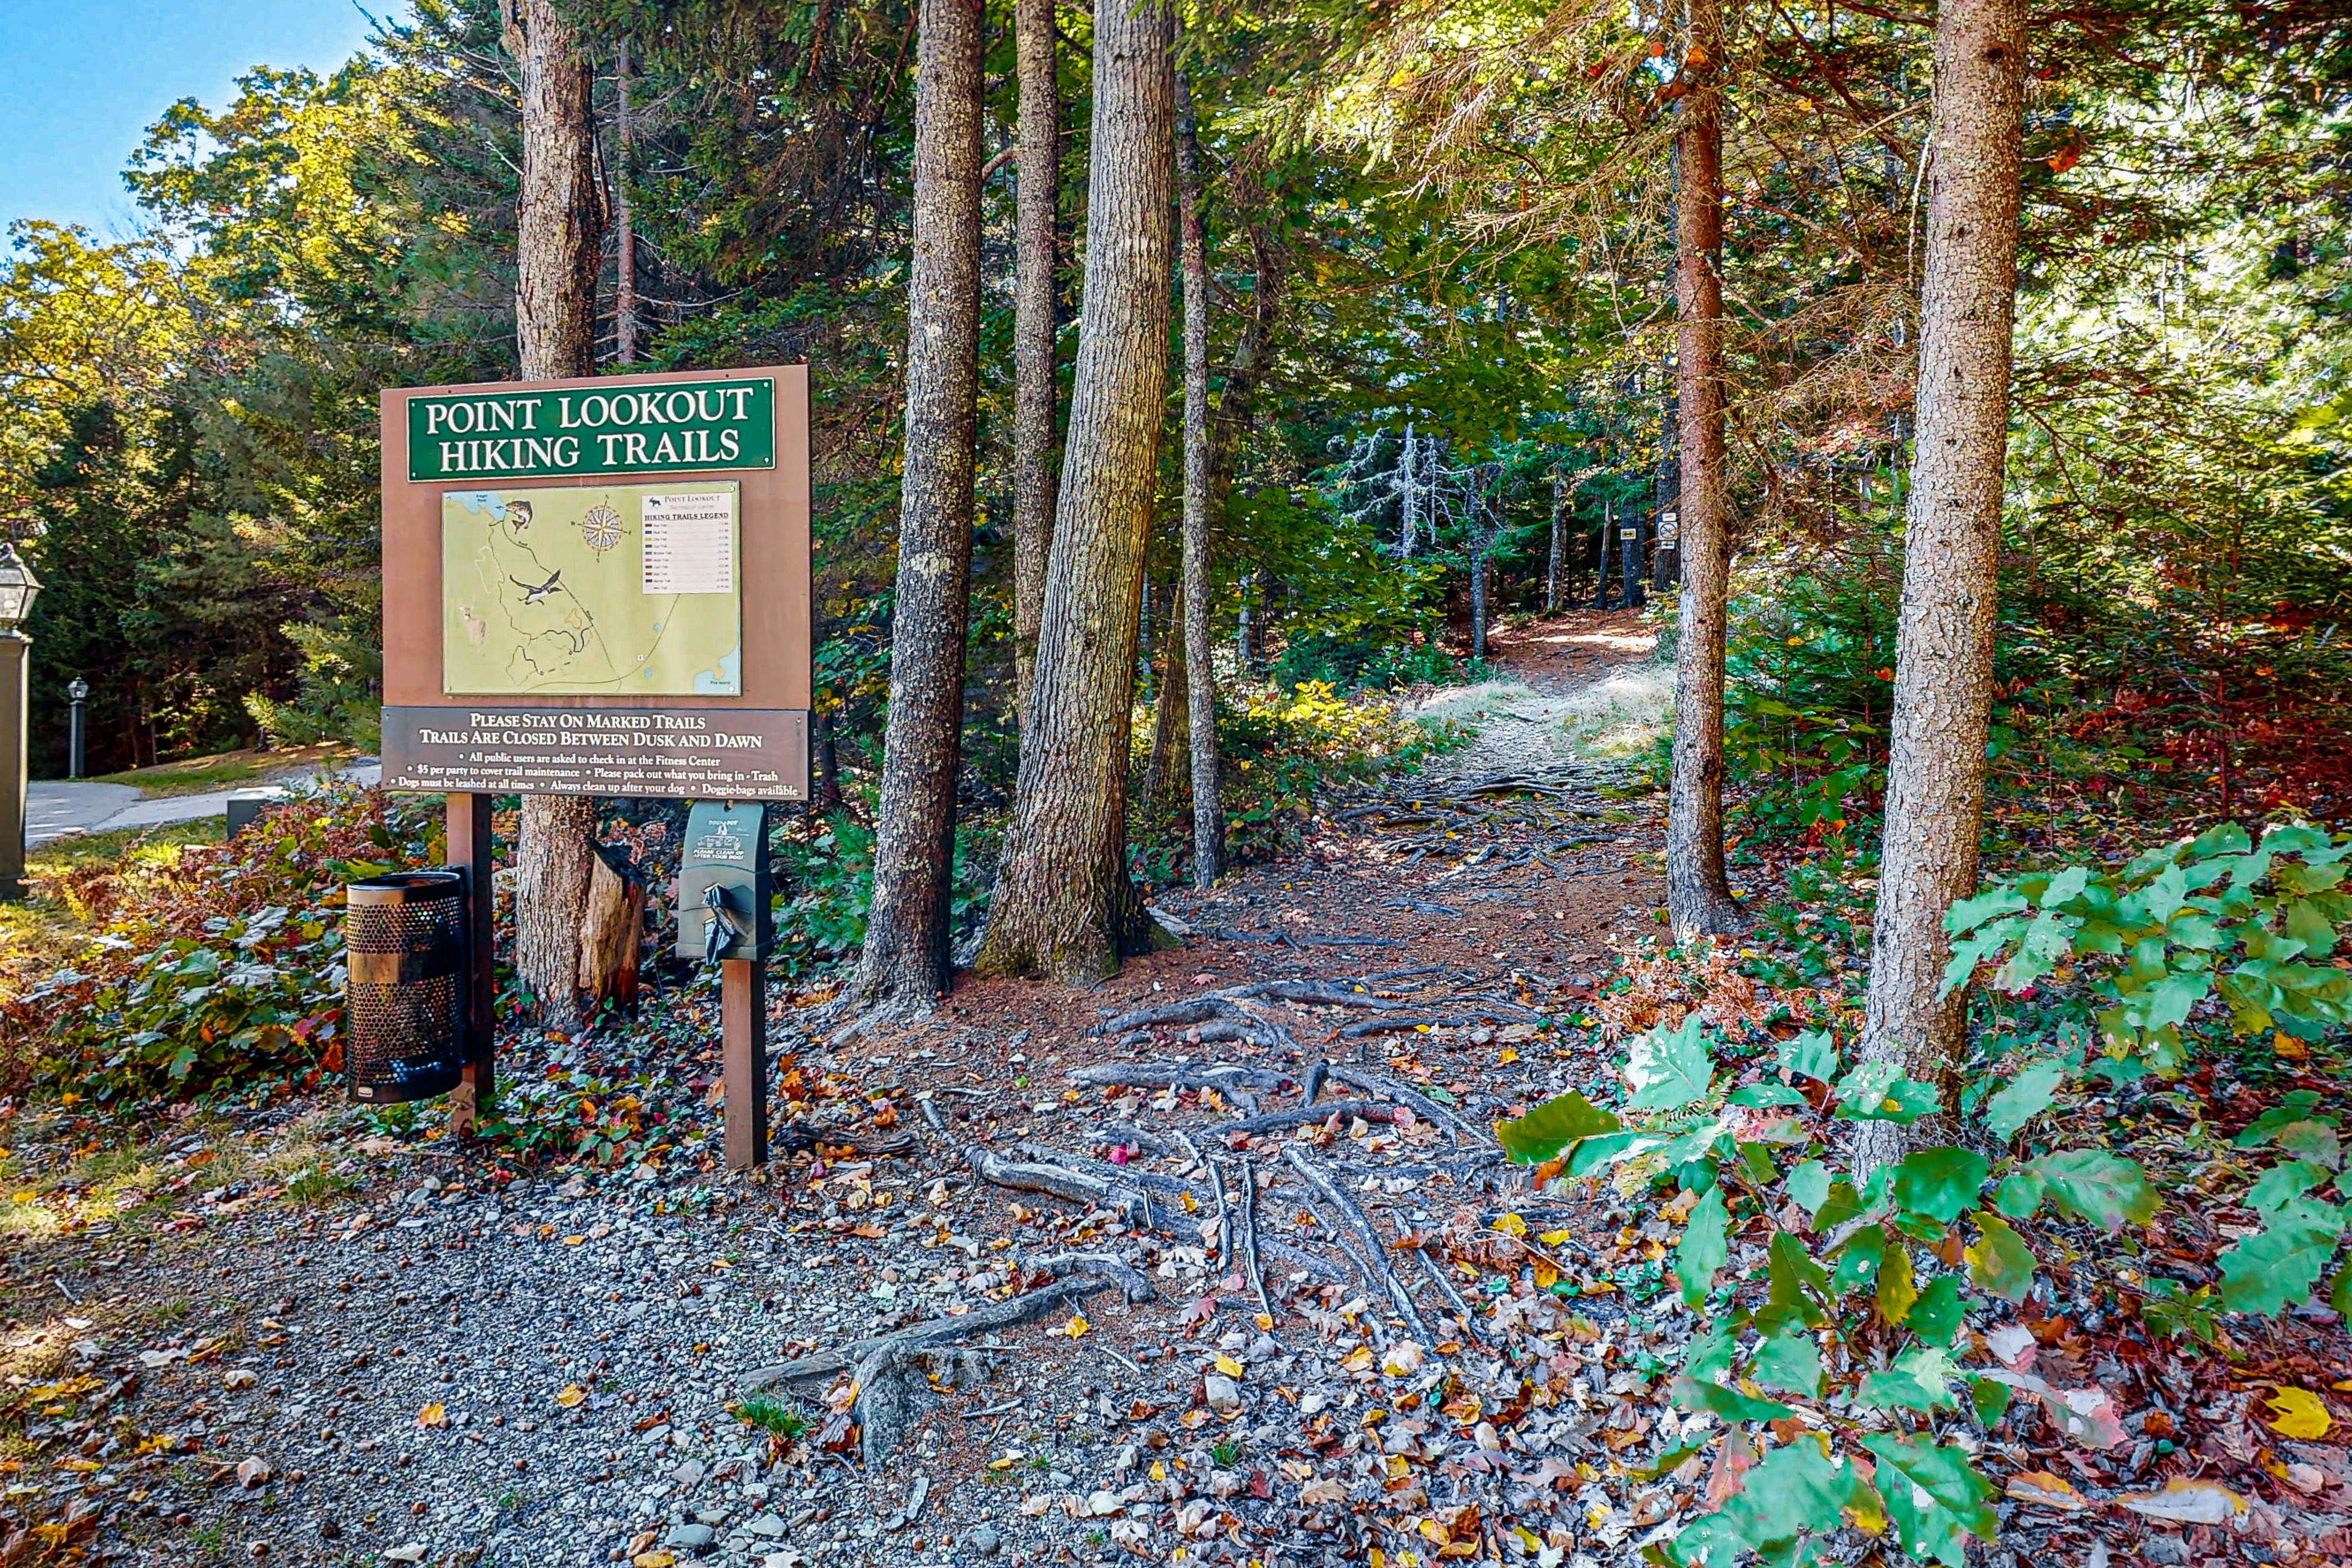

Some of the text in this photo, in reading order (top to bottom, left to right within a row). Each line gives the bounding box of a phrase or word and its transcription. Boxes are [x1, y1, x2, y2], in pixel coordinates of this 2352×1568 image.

[426, 388, 753, 435] POINT LOOKOUT
[439, 429, 739, 472] HIKING TRAILS
[470, 713, 706, 729] PLEASE STAY ON MARKED TRAILS
[420, 729, 762, 748] TRAILS ARE CLOSED BETWEEN DUSK AND DAWN
[469, 753, 482, 762] All
[485, 753, 511, 764] public
[552, 754, 576, 764] asked
[578, 755, 588, 764] to
[589, 755, 614, 764] check
[616, 756, 626, 765] in
[627, 756, 637, 765] at
[639, 755, 653, 765] the
[656, 756, 686, 765] Fitness
[688, 756, 721, 767] Center
[417, 765, 428, 775] $5
[430, 767, 444, 775] per
[446, 767, 468, 776] party
[470, 767, 479, 775] to
[505, 767, 523, 776] trail
[524, 768, 580, 777] maintenance
[594, 769, 621, 778] Please
[623, 770, 644, 780] pack
[648, 771, 662, 779] out
[664, 770, 686, 780] what
[688, 772, 705, 781] you
[708, 771, 733, 782] bring
[735, 771, 744, 780] in
[752, 771, 778, 781] Trash
[399, 777, 420, 788] Dogs
[422, 779, 442, 788] must
[444, 778, 454, 788] be
[456, 779, 487, 788] leashed
[488, 780, 497, 788] at
[498, 779, 509, 788] all
[511, 780, 534, 789] times
[550, 780, 580, 792] Always
[583, 782, 605, 791] clean
[608, 784, 620, 793] up
[621, 783, 642, 792] after
[645, 784, 666, 794] your
[668, 783, 685, 794] dog
[758, 785, 798, 795] available
